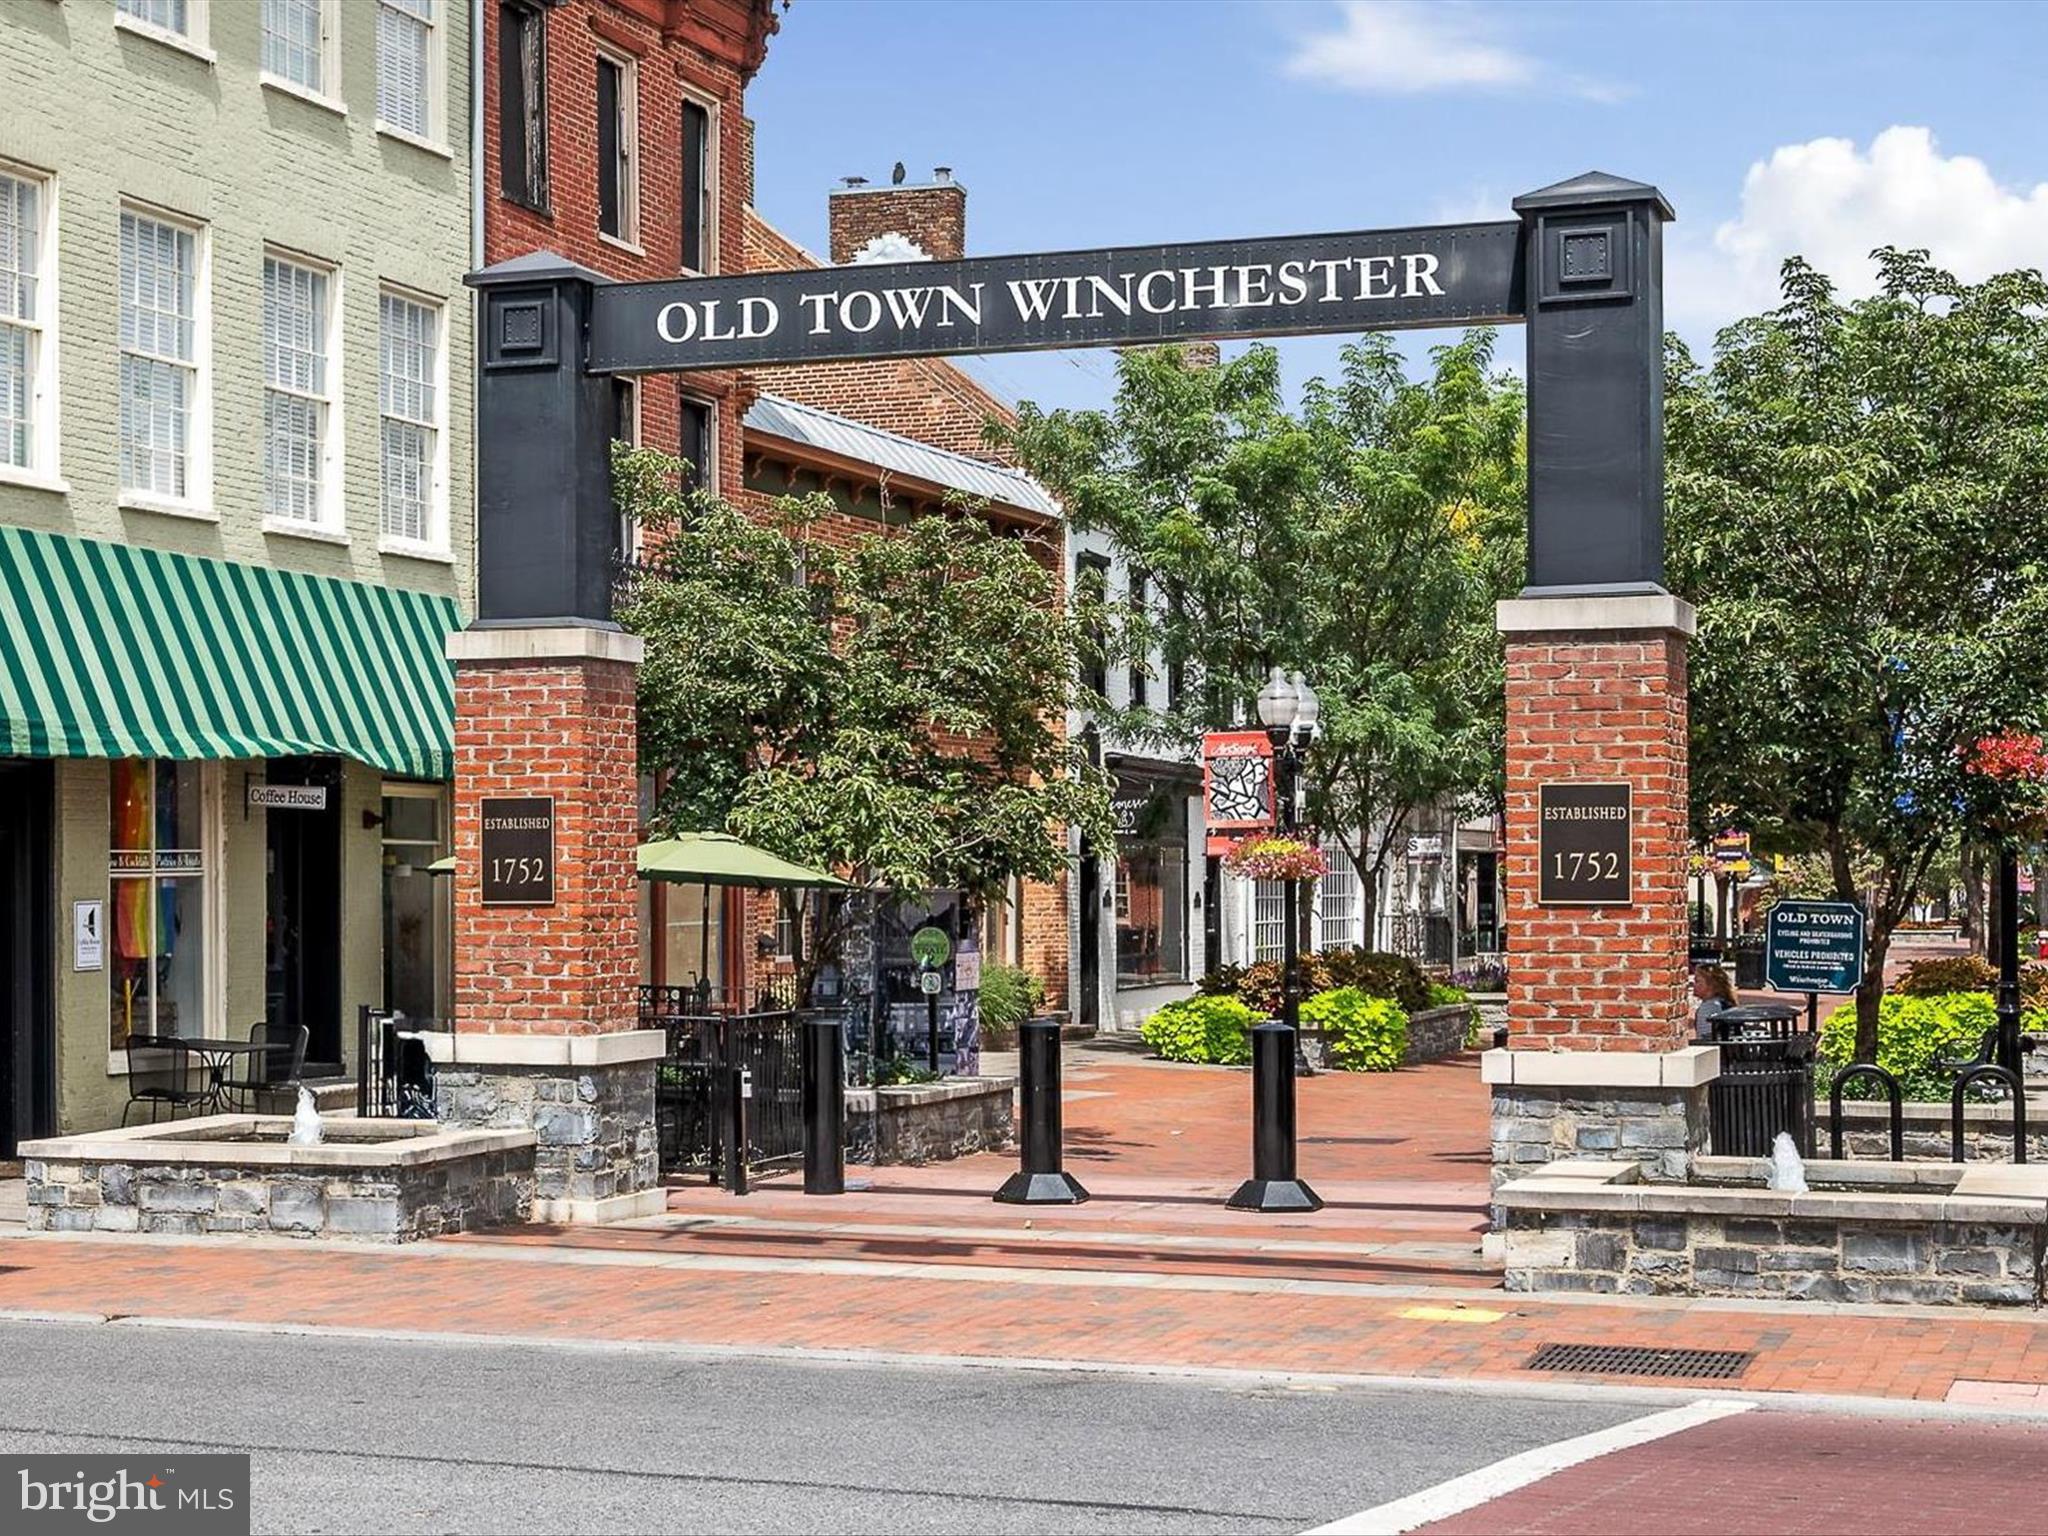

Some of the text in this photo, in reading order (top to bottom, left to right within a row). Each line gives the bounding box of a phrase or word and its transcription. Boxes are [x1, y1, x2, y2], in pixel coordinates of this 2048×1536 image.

[656, 252, 1446, 344] OLD TOWN WINCHESTER
[251, 788, 321, 805] Coffee House
[1544, 806, 1627, 820] ESTABLISHED
[484, 817, 550, 830] ESTABLISHED
[492, 857, 545, 885] 1752
[1554, 852, 1620, 881] 1752
[1777, 912, 1855, 926] OLD TOWN
[1800, 930, 1811, 938] AND
[1774, 949, 1809, 960] VEHICLES
[1811, 951, 1855, 962] PROHIBITED
